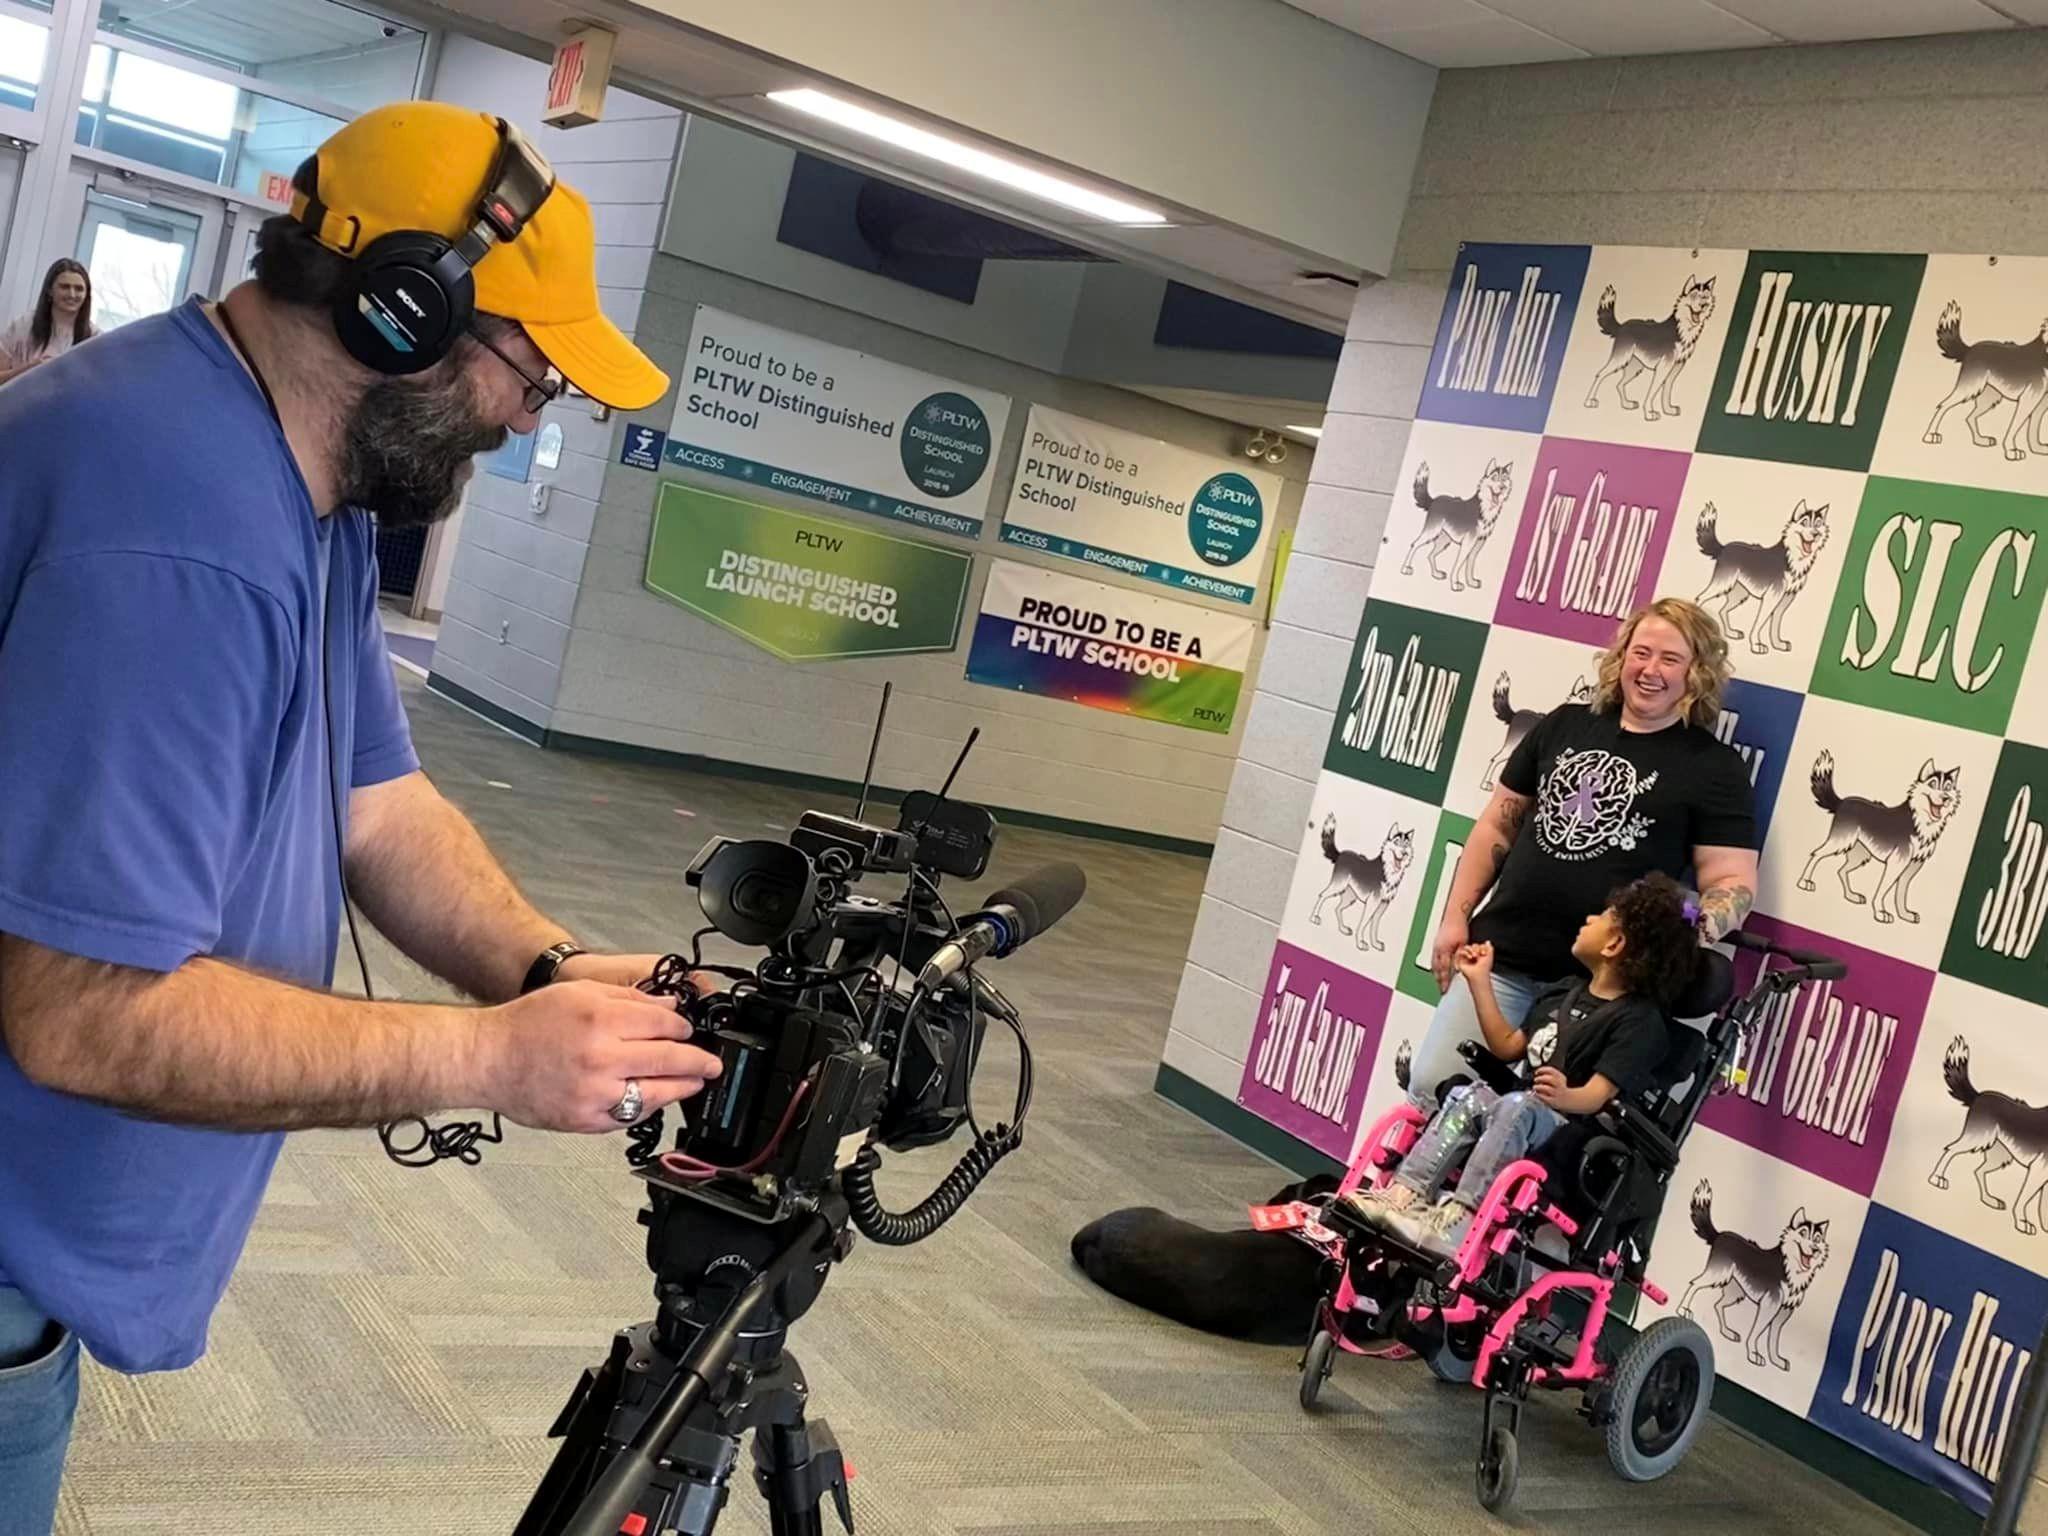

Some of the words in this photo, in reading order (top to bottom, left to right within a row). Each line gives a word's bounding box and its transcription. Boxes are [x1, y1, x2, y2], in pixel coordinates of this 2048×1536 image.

[548, 42, 583, 109] EXIT
[396, 288, 425, 317] SONY
[1437, 264, 1512, 393] PARK
[1493, 266, 1562, 397] HILL
[700, 336, 760, 370] Proud
[768, 357, 786, 377] to
[793, 363, 817, 387] be
[823, 375, 835, 391] a
[1724, 271, 1893, 426] HUSKY
[687, 395, 759, 430] School
[693, 366, 754, 398] PLTW
[759, 386, 894, 438] Distinguished
[942, 411, 981, 431] PLTW
[910, 426, 984, 455] DISTINGUISHED
[924, 444, 964, 464] SCHOOL
[1031, 432, 1080, 461] Proud
[1085, 450, 1100, 466] to
[1104, 453, 1125, 474] be
[1128, 464, 1138, 478] a
[675, 447, 725, 470] ACCESS
[771, 472, 852, 502] ENGAGEMENT
[894, 504, 972, 533] ACHIEVEMENT
[924, 465, 956, 478] LAUNCH
[1019, 483, 1077, 512] School
[1025, 458, 1073, 485] PLTW
[1076, 473, 1185, 516] Distinguished
[1223, 488, 1255, 507] PLTW
[795, 530, 844, 553] PLTW
[1196, 503, 1257, 529] DISTINGUISHED
[1206, 519, 1239, 537] SCHOOL
[1515, 468, 1577, 604] 1ST
[1560, 471, 1659, 621] GRADE
[720, 549, 898, 607] DISTINGUISHED
[1008, 530, 1048, 549] ACCESS
[1084, 548, 1148, 574] ENGAGEMENT
[1181, 574, 1246, 599] ACHIEVEMENT
[705, 567, 806, 608] LAUNCH
[808, 591, 899, 629] SCHOOL
[1840, 512, 2037, 693] SLC
[1011, 624, 1081, 659] PLTW
[1082, 642, 1181, 683] SCHOOL
[1019, 597, 1107, 635] PROUD
[1114, 618, 1145, 644] TO
[1150, 628, 1183, 653] BE
[1185, 637, 1203, 659] A
[1193, 707, 1226, 723] PLTW
[1341, 626, 1394, 752] 2ND
[1380, 634, 1461, 772] GRADE
[1554, 844, 1609, 861] AWARENESS
[1976, 784, 2048, 960] 3RD
[1255, 963, 1307, 1094] 5TH
[1291, 980, 1366, 1125] GRADE
[1782, 978, 1900, 1146] GRADE
[1841, 1248, 1953, 1442] PARK
[1933, 1290, 2032, 1484] HILL
